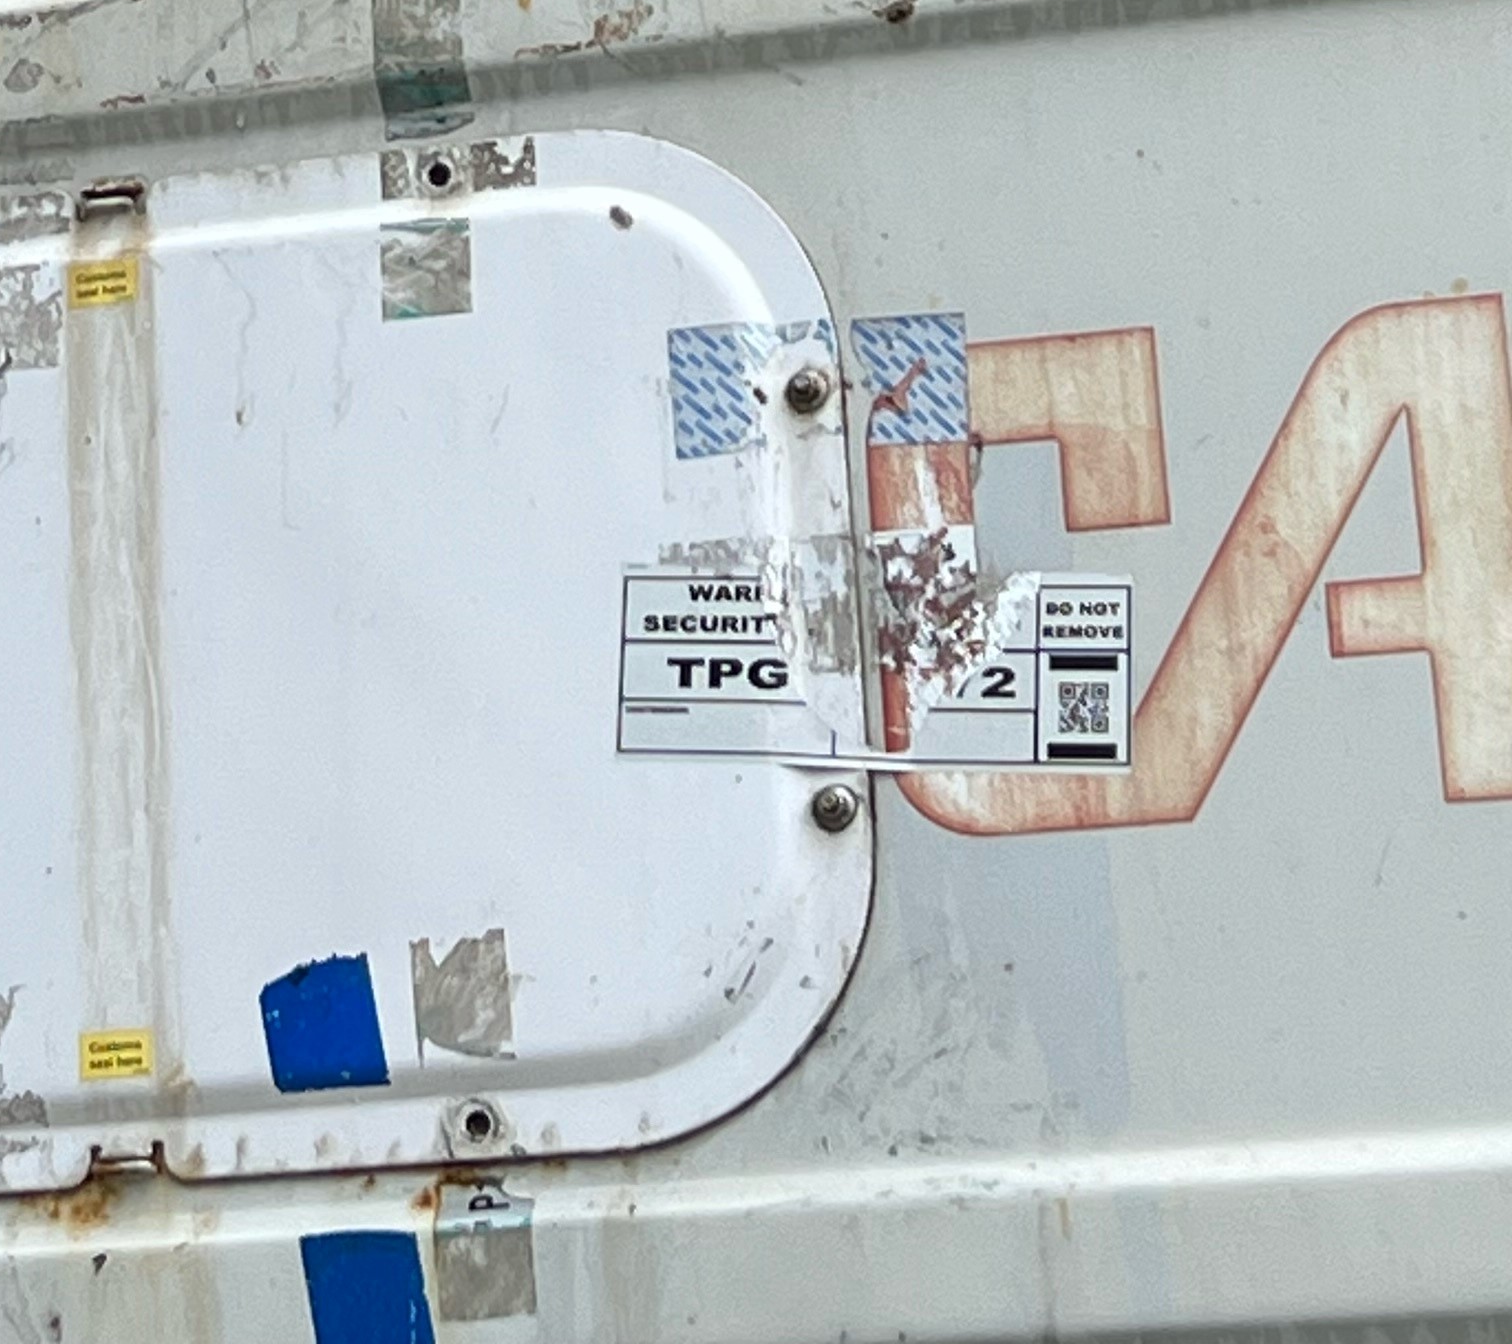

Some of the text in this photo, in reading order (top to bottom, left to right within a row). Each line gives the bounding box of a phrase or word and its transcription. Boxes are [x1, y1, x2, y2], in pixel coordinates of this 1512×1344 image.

[688, 583, 763, 602] WAR
[1045, 601, 1121, 617] DO NOT
[1042, 624, 1125, 639] REMOVE
[666, 656, 789, 690] TPG
